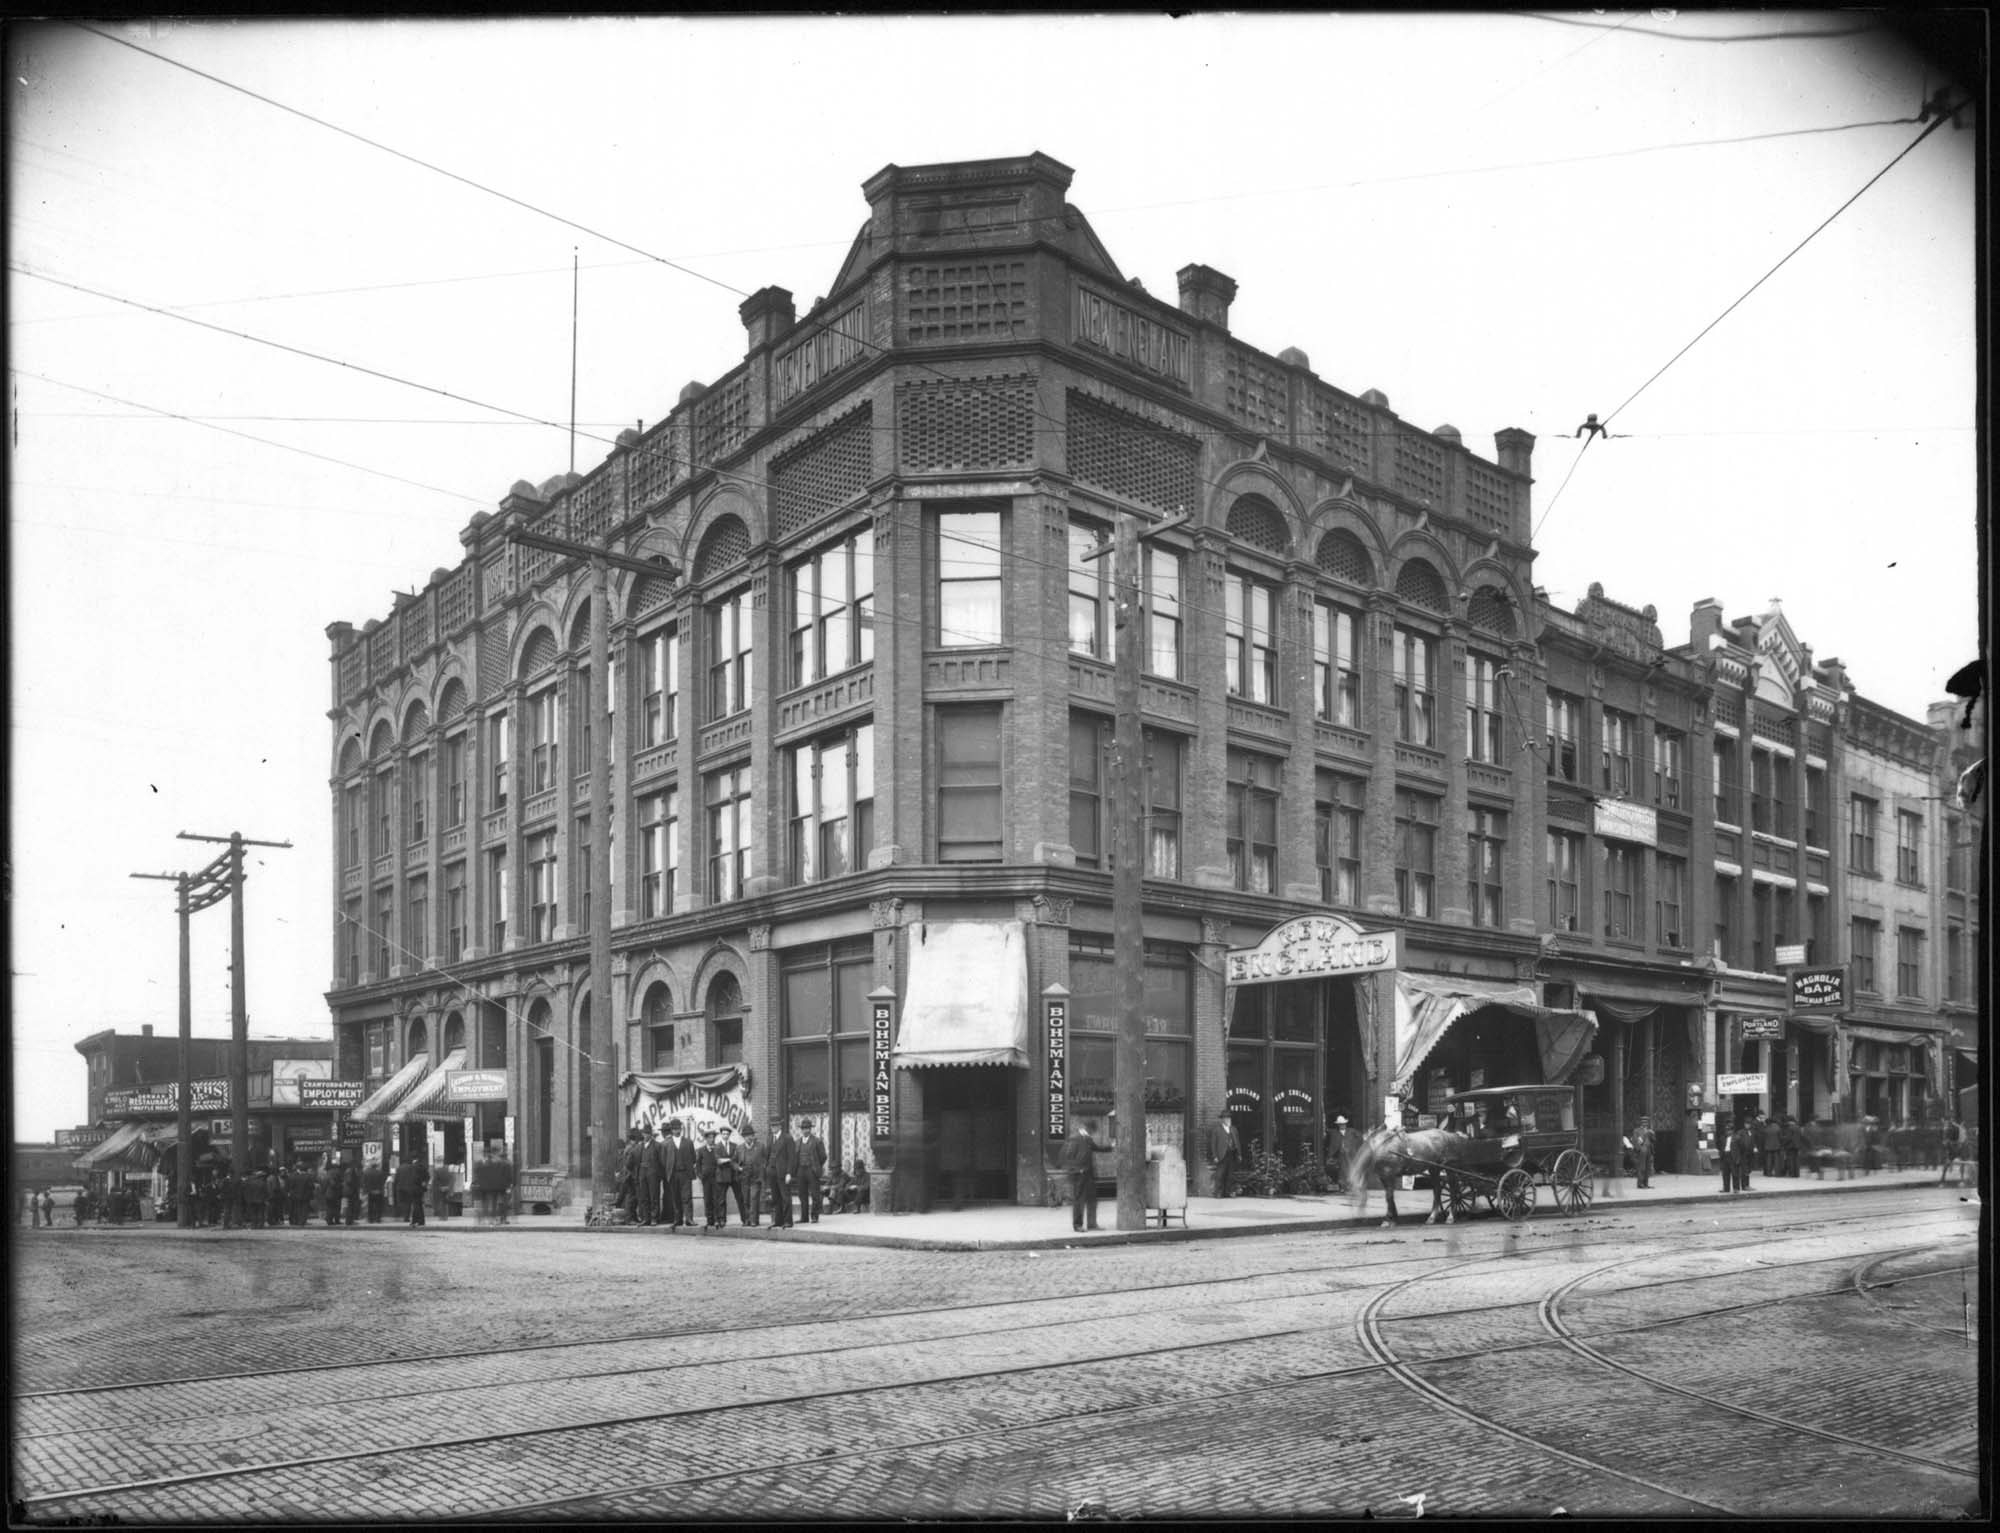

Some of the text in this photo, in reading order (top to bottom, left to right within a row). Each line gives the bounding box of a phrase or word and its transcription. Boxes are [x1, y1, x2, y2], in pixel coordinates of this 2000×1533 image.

[1079, 289, 1114, 355] NEW
[1278, 920, 1341, 949] NEW
[1230, 939, 1391, 981] ENGLAND
[1795, 974, 1840, 988] MAGNOLIA
[1804, 983, 1832, 993] BAR
[1823, 991, 1840, 1003] BEER
[875, 1009, 889, 1136] BOHEMIAN BEER
[1050, 1007, 1064, 1134] BOHEMIAN BEER
[303, 1089, 362, 1098] EMPLOYMENT
[670, 1084, 705, 1114] NOME
[1274, 1091, 1285, 1102] NEW
